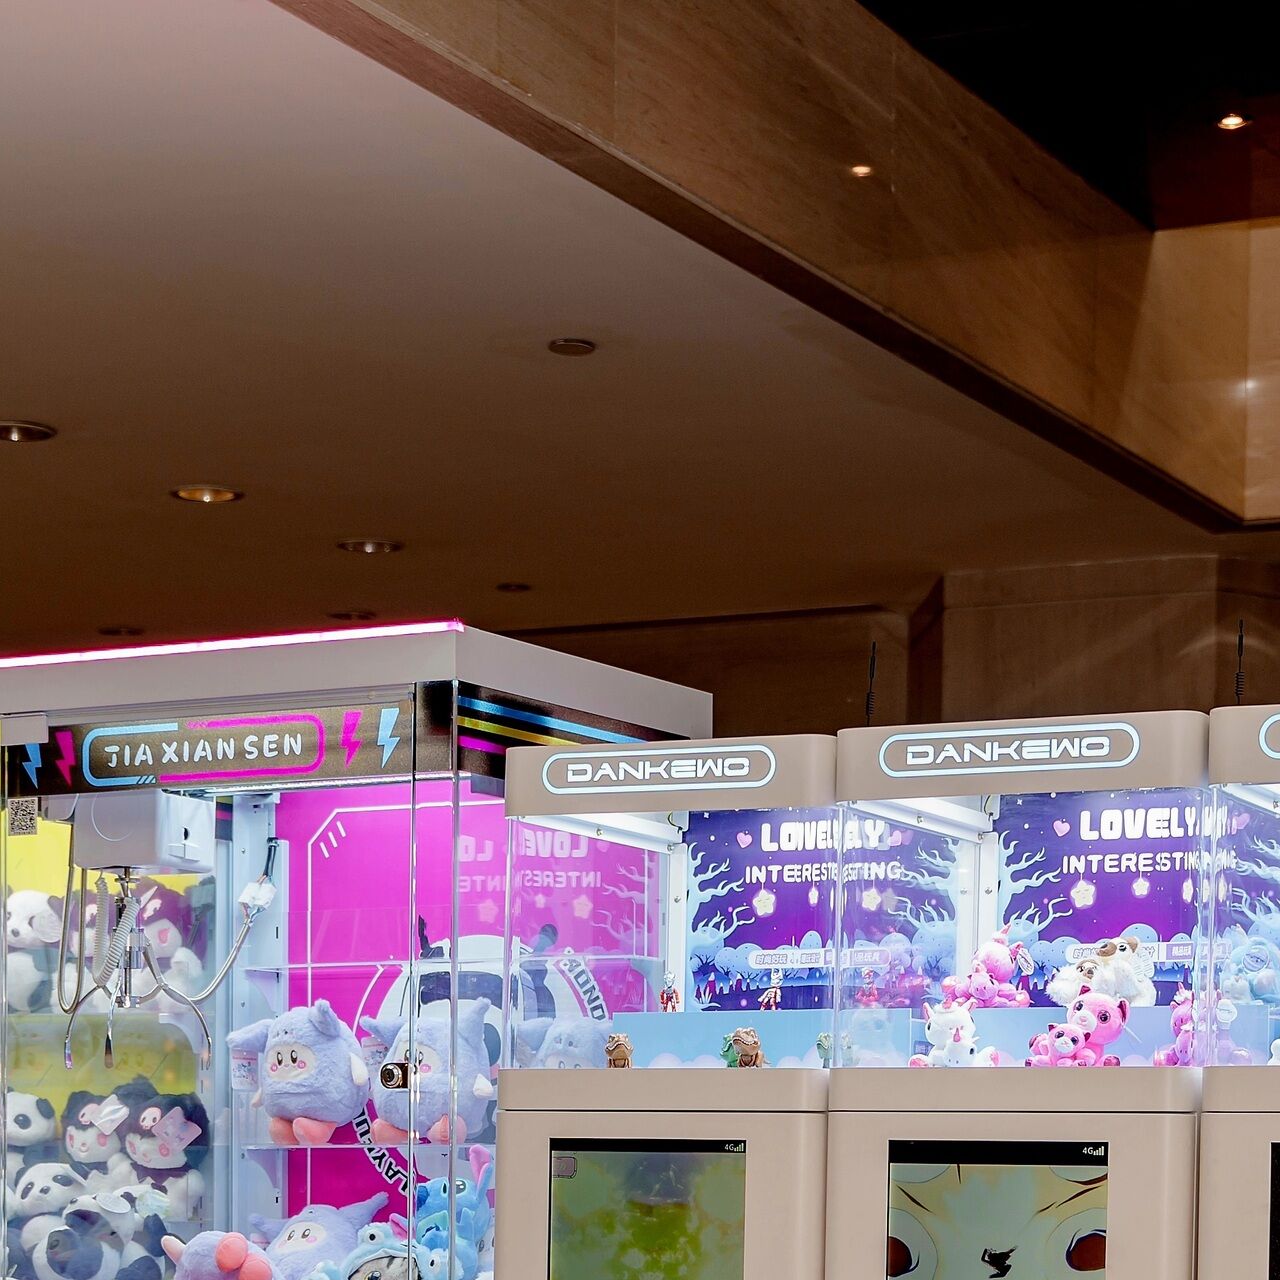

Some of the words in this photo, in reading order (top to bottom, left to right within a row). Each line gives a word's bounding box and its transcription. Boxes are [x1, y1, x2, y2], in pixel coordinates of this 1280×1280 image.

[104, 742, 154, 768] JIA
[161, 736, 236, 765] XIAN
[245, 733, 303, 759] SEN
[906, 736, 1111, 765] DANKEWO
[567, 755, 750, 783] DANKEWO
